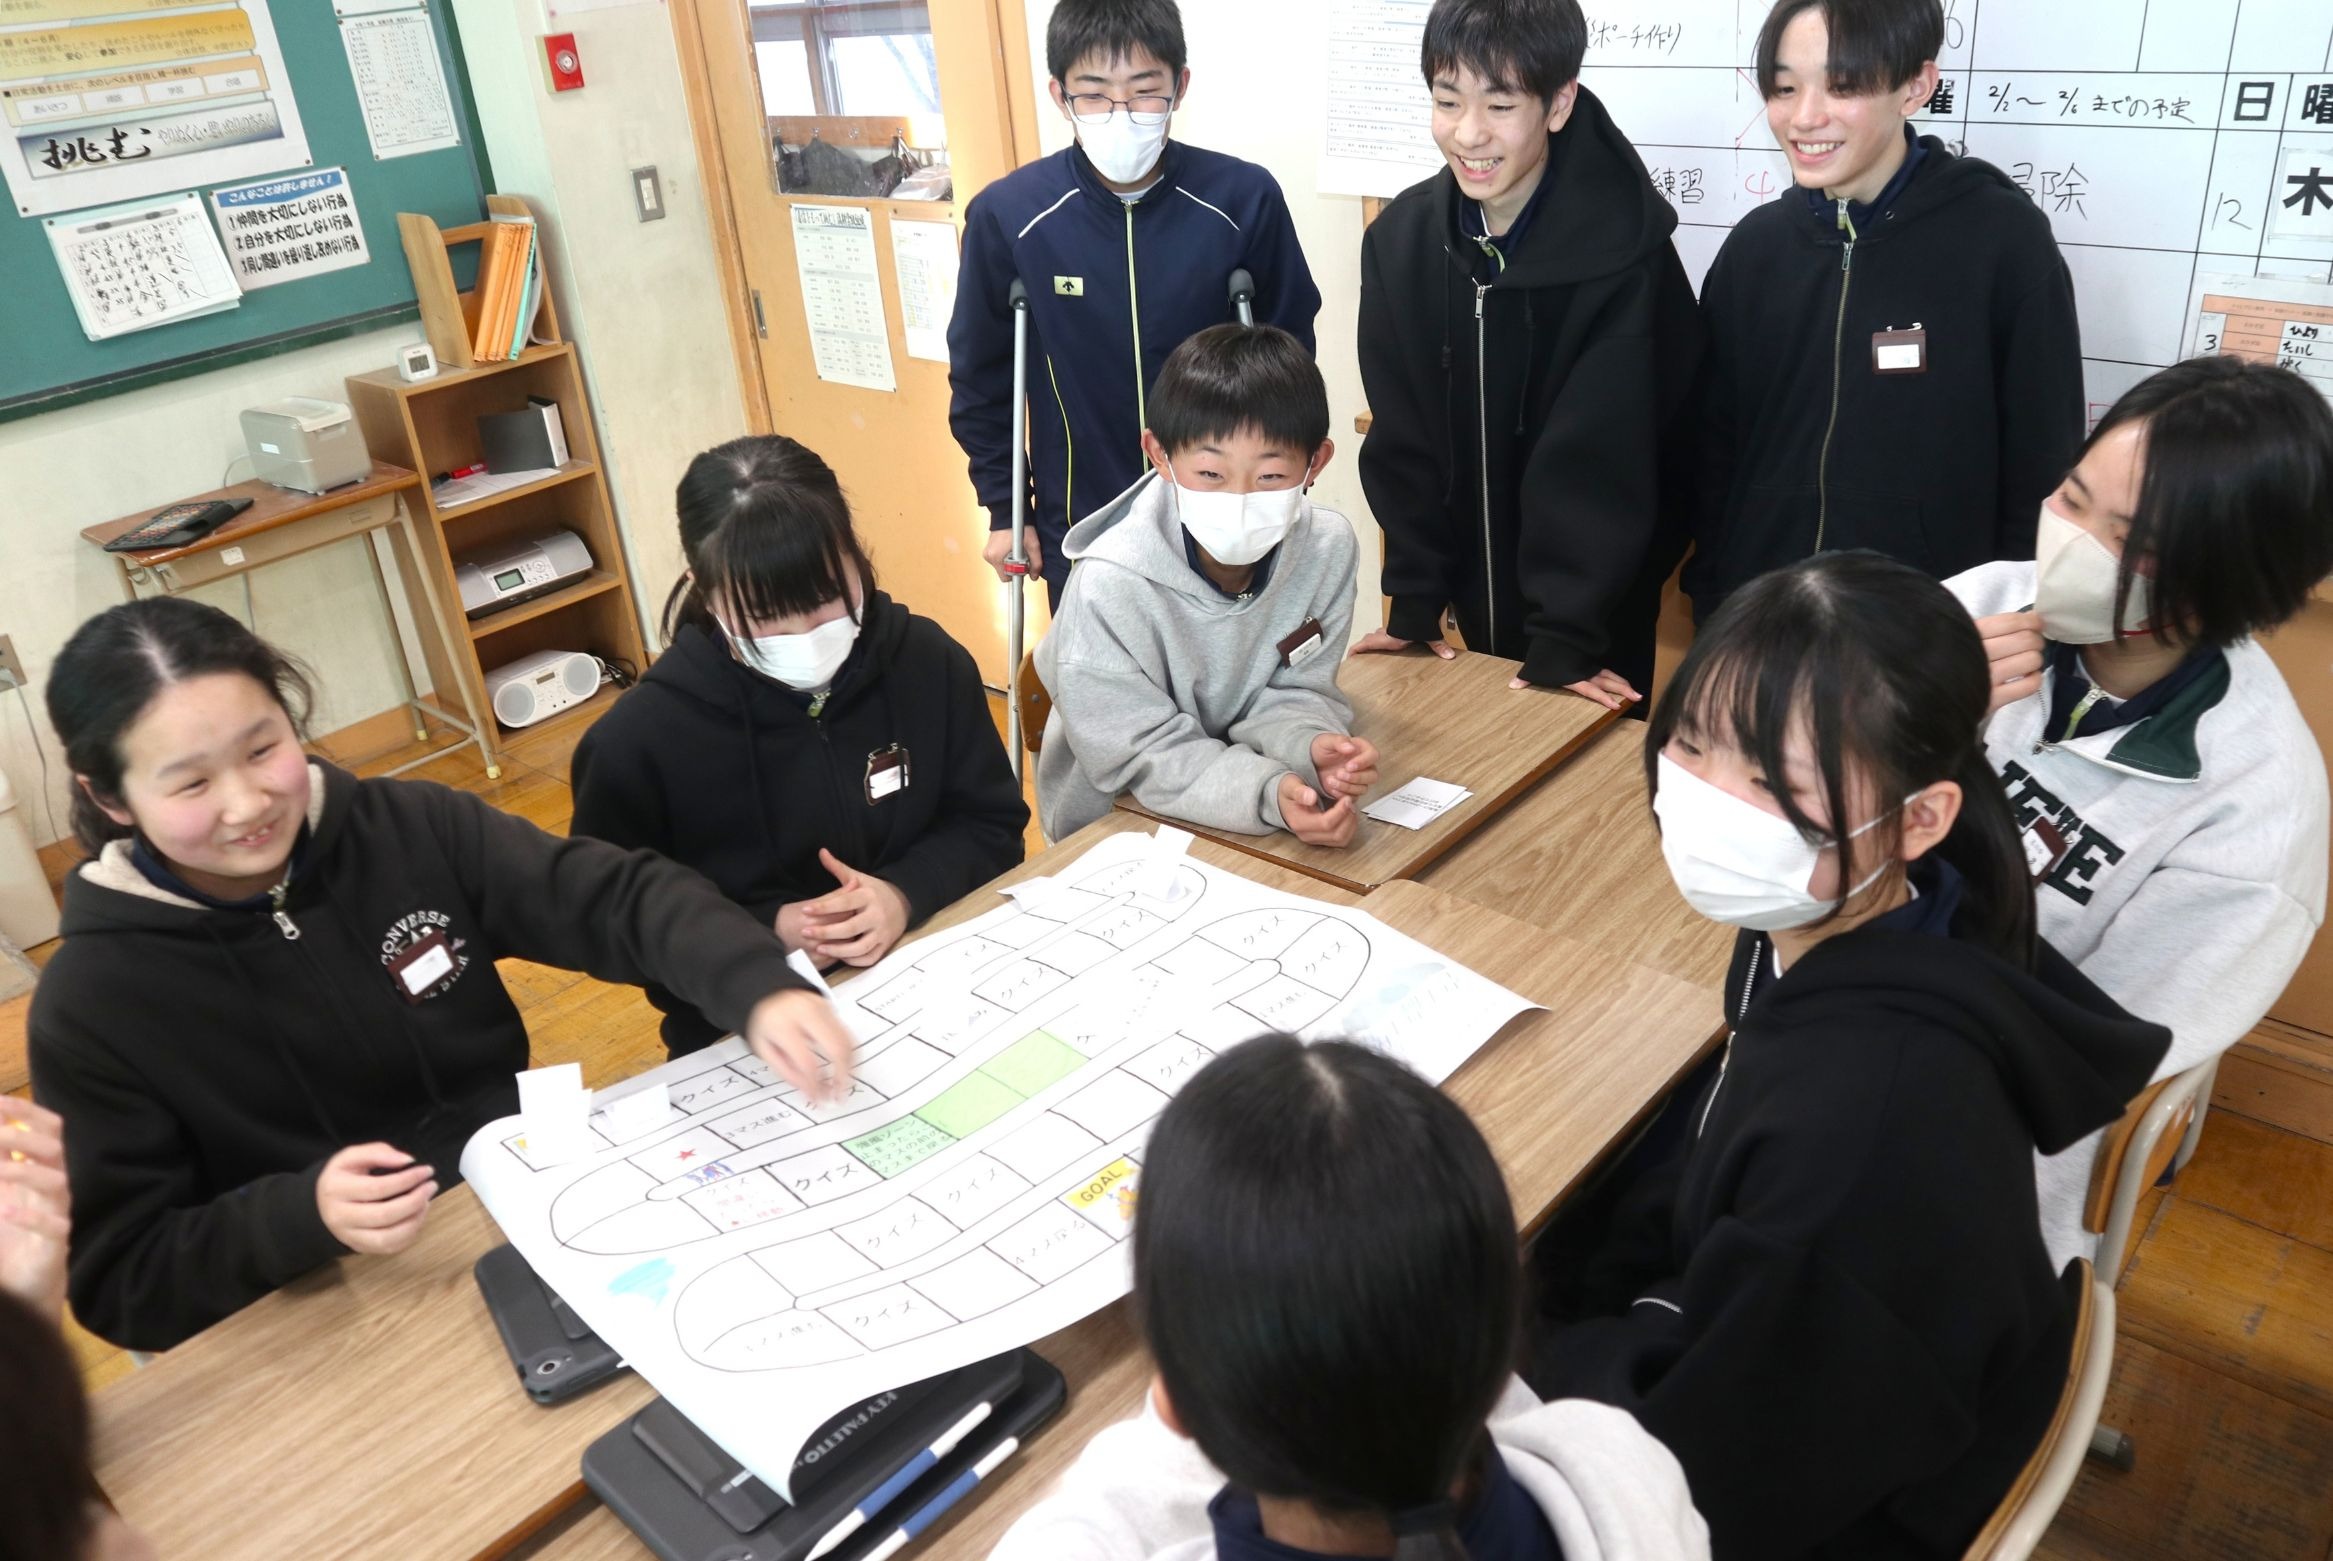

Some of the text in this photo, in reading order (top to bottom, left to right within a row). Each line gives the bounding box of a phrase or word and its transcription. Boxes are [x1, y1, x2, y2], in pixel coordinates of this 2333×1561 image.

[2233, 81, 2275, 122] 日
[40, 127, 153, 170] 挑む
[1650, 167, 1704, 204] 練習
[2283, 167, 2333, 216] 木
[2211, 193, 2253, 231] 12
[2204, 334, 2218, 351] 3
[380, 910, 451, 966] CONVERSE
[1079, 1169, 1123, 1203] GOAL
[804, 1391, 898, 1464] KEY PALETTO
